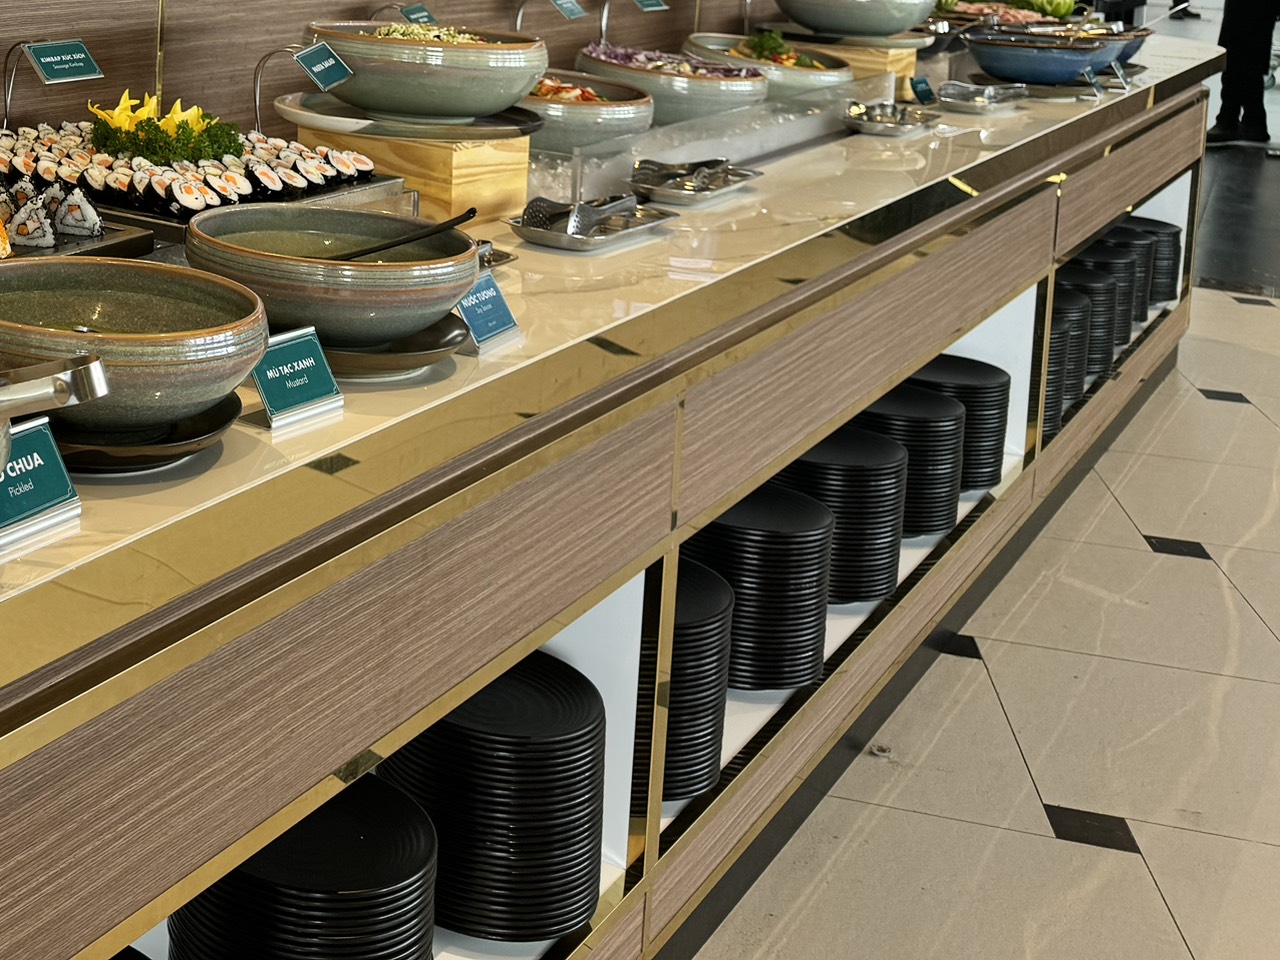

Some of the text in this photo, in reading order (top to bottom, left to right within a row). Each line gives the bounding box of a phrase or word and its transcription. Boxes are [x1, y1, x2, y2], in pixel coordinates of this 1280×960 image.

[266, 356, 316, 380] MÙ TẠC XANH
[285, 373, 309, 389] Mustard
[6, 451, 45, 478] CHUA
[8, 478, 34, 498] Pickled
